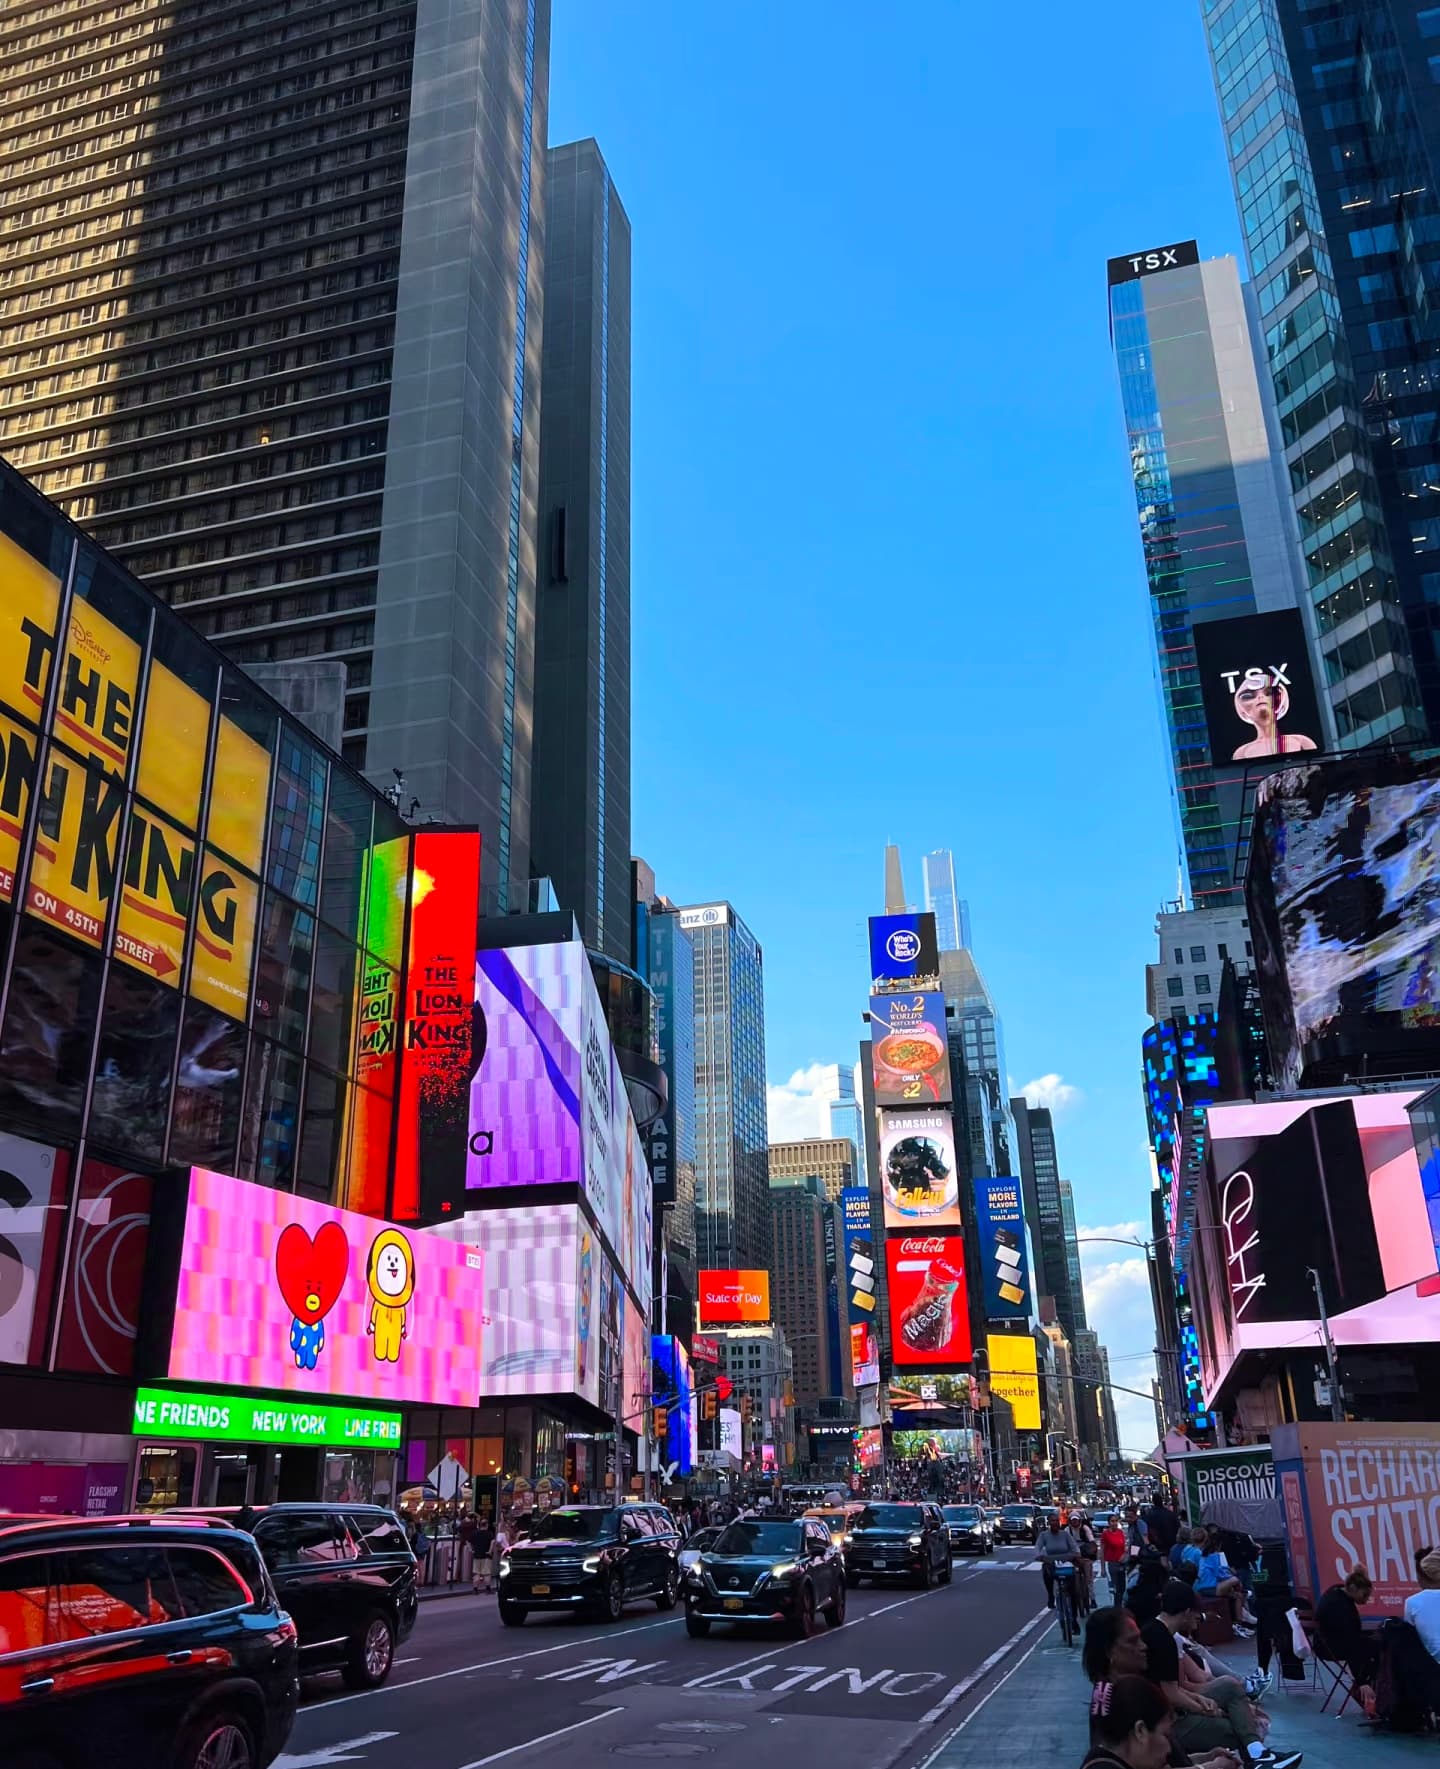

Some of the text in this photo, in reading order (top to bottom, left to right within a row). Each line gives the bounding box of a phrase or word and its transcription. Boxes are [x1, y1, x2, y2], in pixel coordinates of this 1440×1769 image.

[1128, 249, 1178, 273] TSX
[21, 616, 132, 751] THE
[1220, 663, 1292, 694] TSX
[71, 752, 238, 945] KING
[34, 892, 57, 915] ON
[65, 911, 99, 937] 45TH
[115, 935, 155, 965] STREET
[893, 934, 914, 944] Who's
[424, 967, 458, 982] THE
[416, 989, 463, 1017] LION
[407, 1019, 470, 1051] KING
[902, 1073, 921, 1082] ONLY
[903, 1081, 922, 1098] $2
[652, 1048, 670, 1184] SARE
[888, 1117, 943, 1130] SAMSUNG
[988, 1192, 1018, 1202] MORE
[989, 1214, 1020, 1222] THAILAND
[900, 1237, 947, 1255] Coca-Cola
[705, 1292, 763, 1305] State of Day
[992, 1387, 1036, 1398] together
[135, 1400, 157, 1424] NE
[160, 1402, 231, 1429] FRIENDS
[252, 1410, 288, 1432] NEW
[290, 1413, 327, 1435] YORK
[344, 1418, 370, 1438] LINE
[1320, 1447, 1440, 1507] RECHAR
[88, 1485, 119, 1497] FLAGSHIP
[700, 1663, 949, 1697] ONLY
